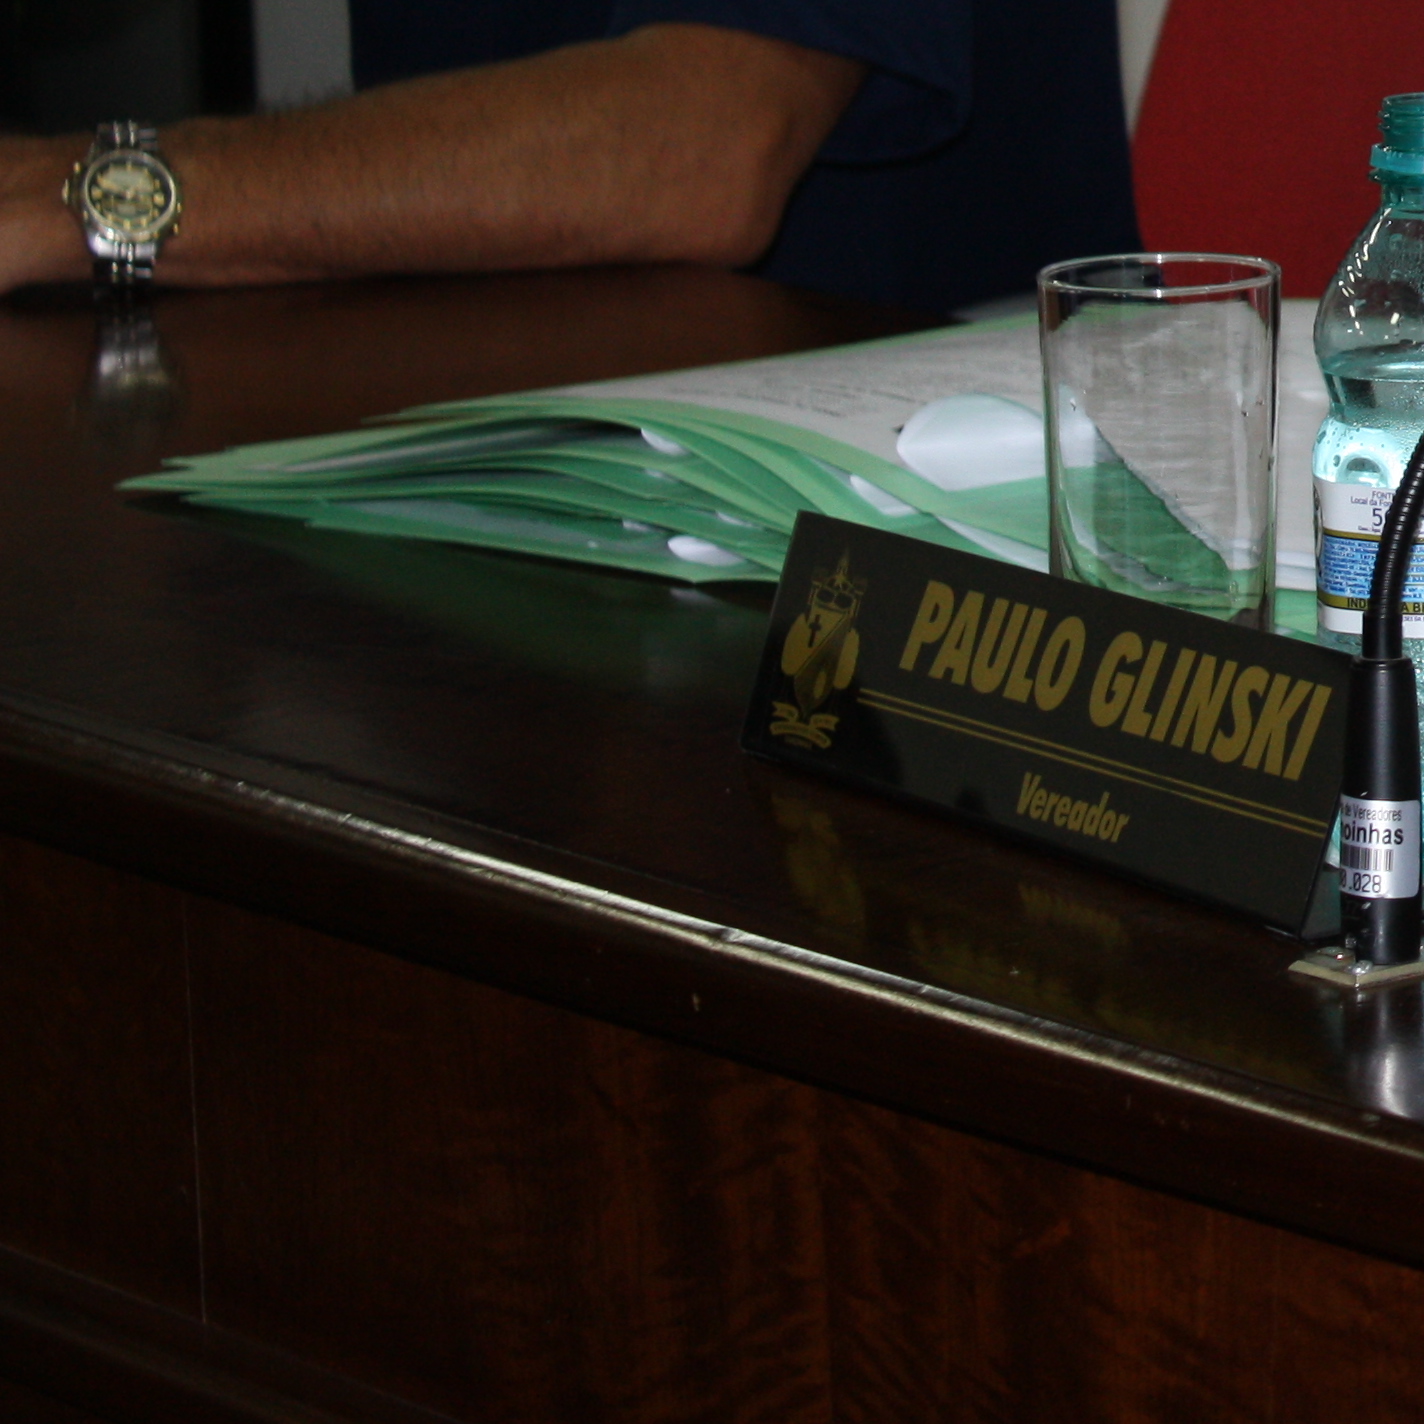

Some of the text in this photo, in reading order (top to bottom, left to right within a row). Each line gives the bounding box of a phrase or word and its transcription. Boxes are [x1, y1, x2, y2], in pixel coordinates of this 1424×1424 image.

[899, 580, 1333, 781] PAULO GLINSKI
[1015, 771, 1130, 844] Vereador
[1353, 803, 1402, 821] Vereadores
[1341, 820, 1404, 845] oinhas
